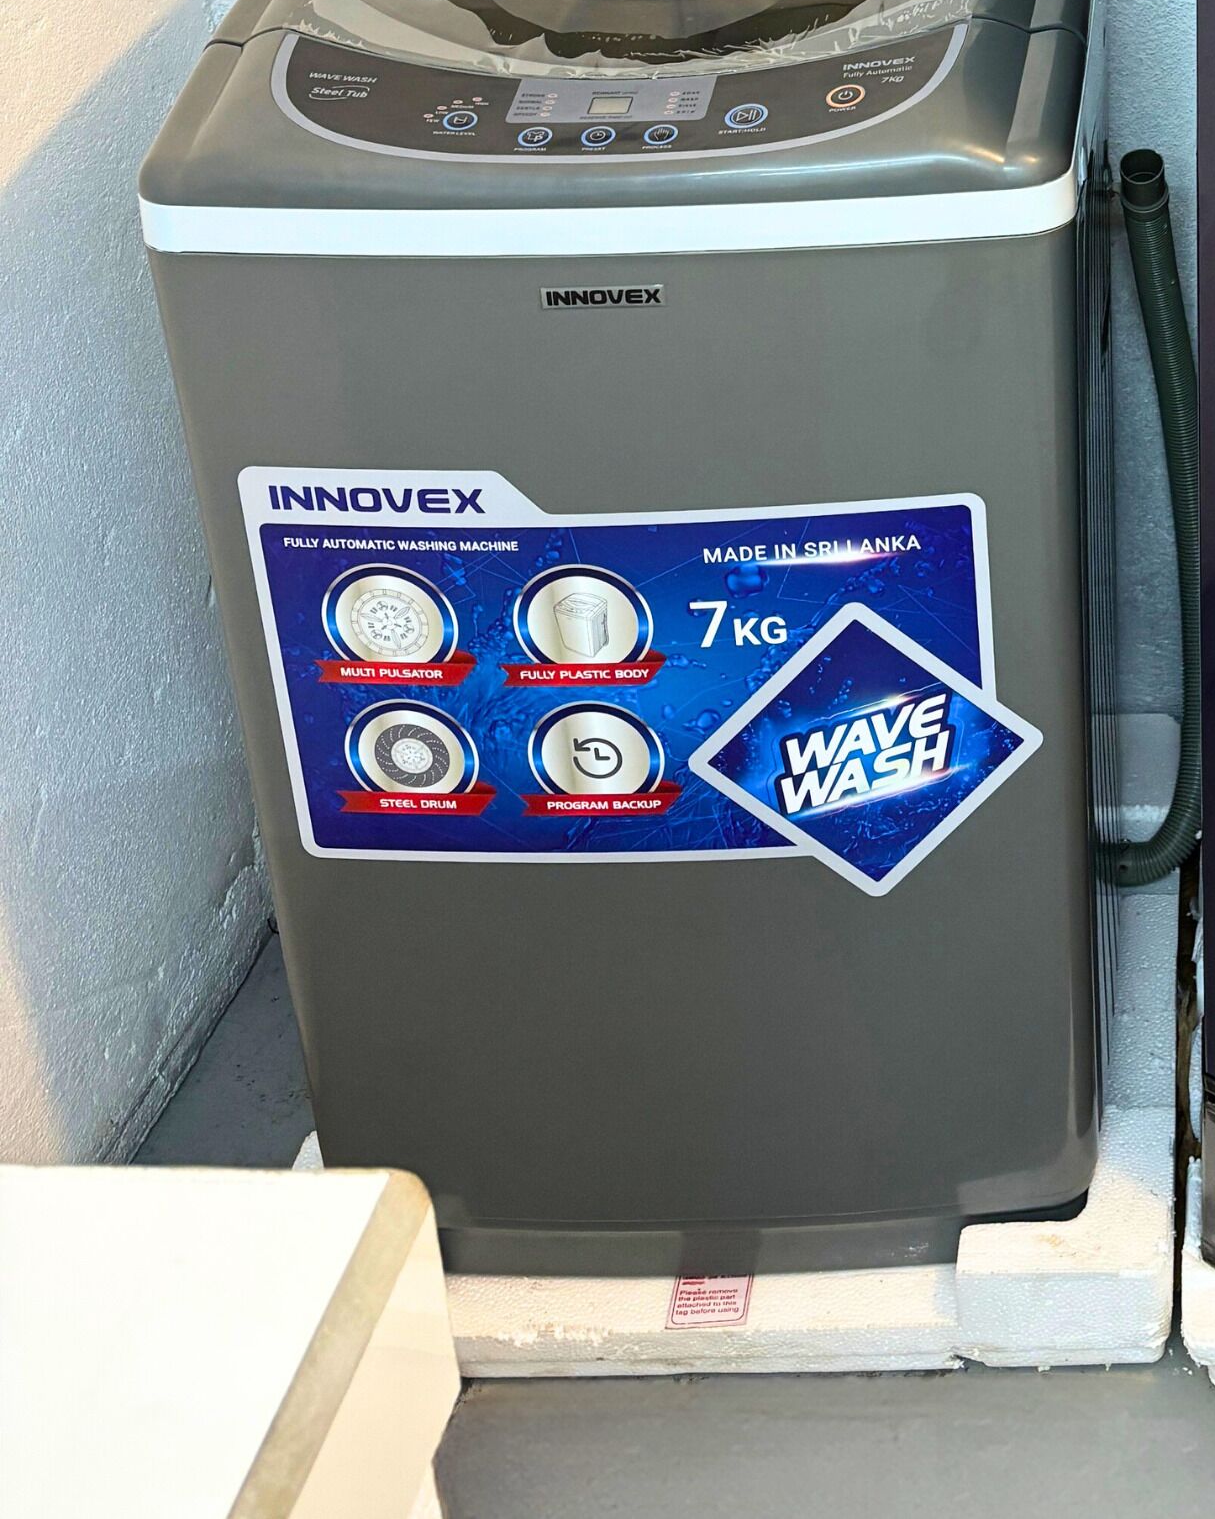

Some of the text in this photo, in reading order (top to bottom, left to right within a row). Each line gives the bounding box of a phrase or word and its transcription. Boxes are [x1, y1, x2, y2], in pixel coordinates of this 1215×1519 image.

[843, 56, 916, 71] INNOVEX
[309, 72, 378, 83] WAVE WASH
[843, 65, 912, 79] Fully Automatic
[311, 87, 368, 98] Steel Tub
[546, 289, 661, 306] INNOVEX
[268, 485, 486, 514] INNOVEX
[283, 537, 519, 552] FULLY AUTOMATIC WASHING MACHINE
[703, 534, 922, 564] MADE IN SRI LANKA
[689, 600, 787, 648] 7 KG
[340, 667, 443, 679] MULTI PULSATOR
[519, 668, 649, 680] FULLY PLASTIC BODY
[786, 694, 946, 776] WAVE
[780, 730, 950, 814] WASH
[379, 798, 457, 809] STEEL DRUM
[547, 800, 661, 810] PROGRAM BACKUP
